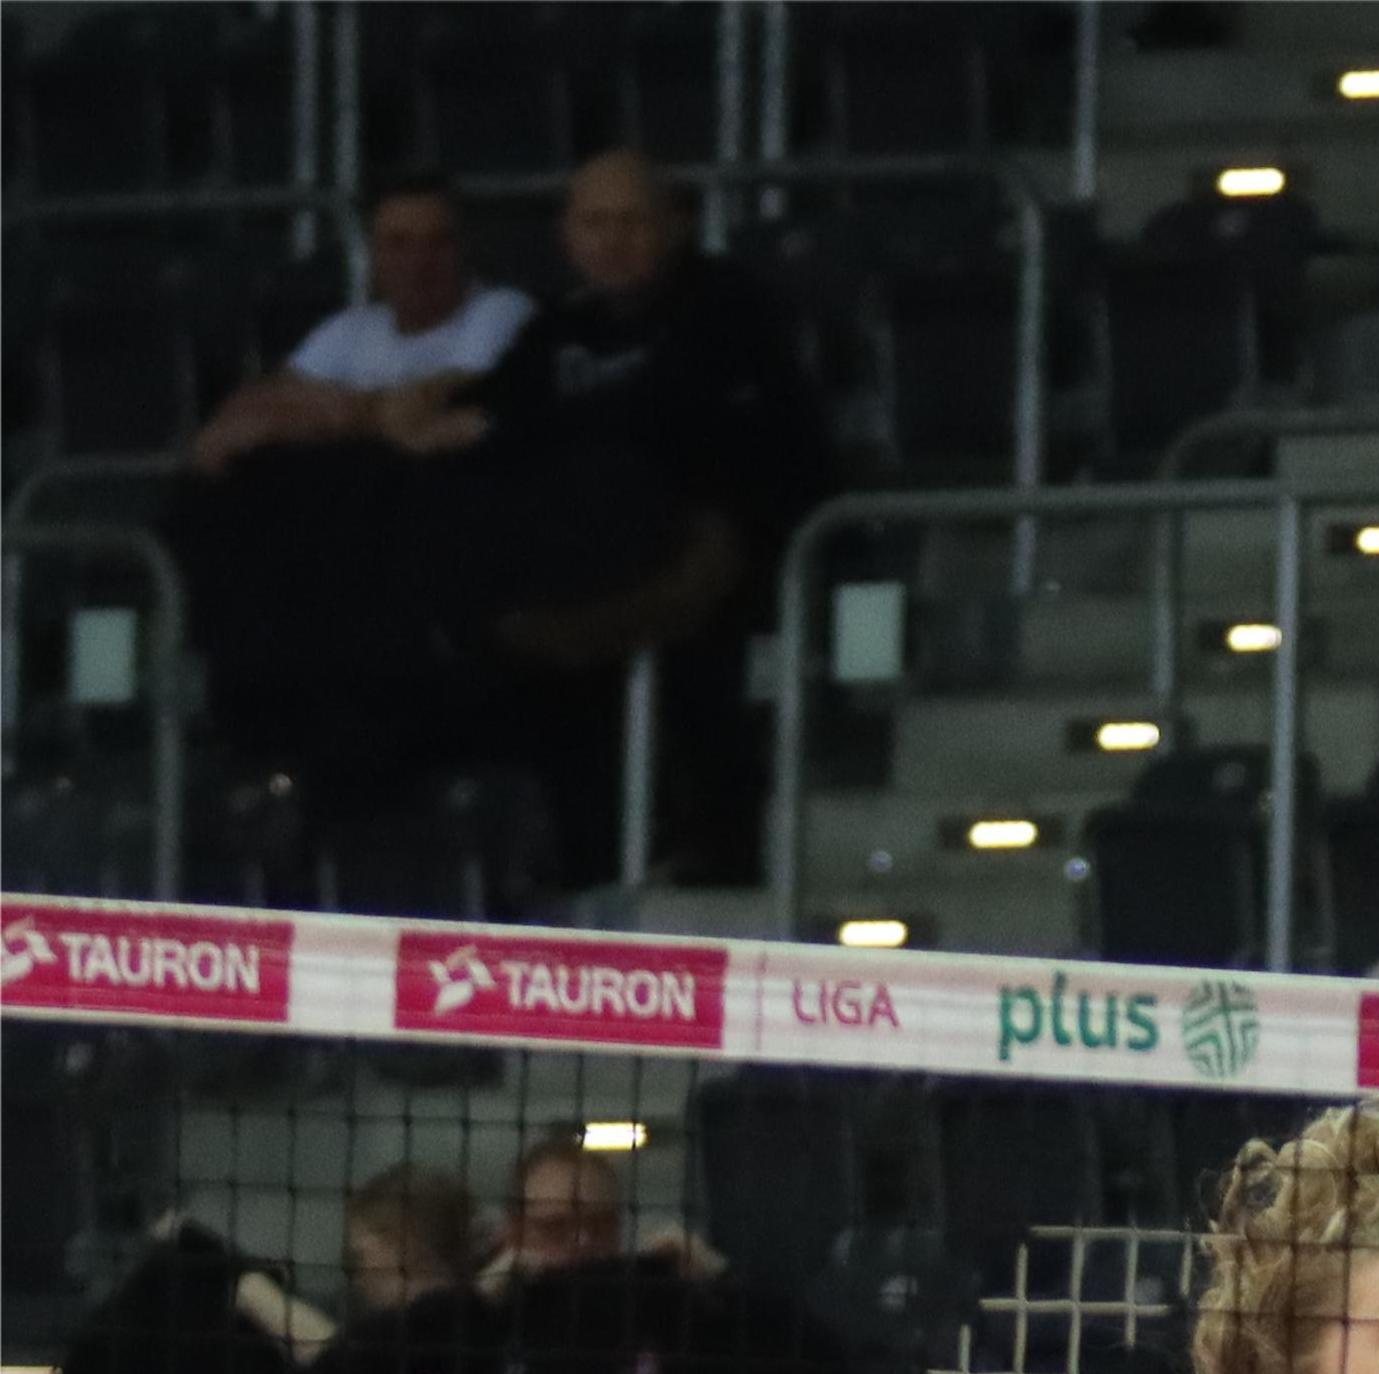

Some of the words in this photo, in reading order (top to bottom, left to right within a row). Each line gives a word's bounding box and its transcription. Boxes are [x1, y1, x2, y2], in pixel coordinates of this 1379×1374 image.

[62, 931, 260, 994] TAURON
[500, 959, 696, 1021] TAURON
[792, 979, 901, 1030] LIGA
[999, 973, 1158, 1060] plus
